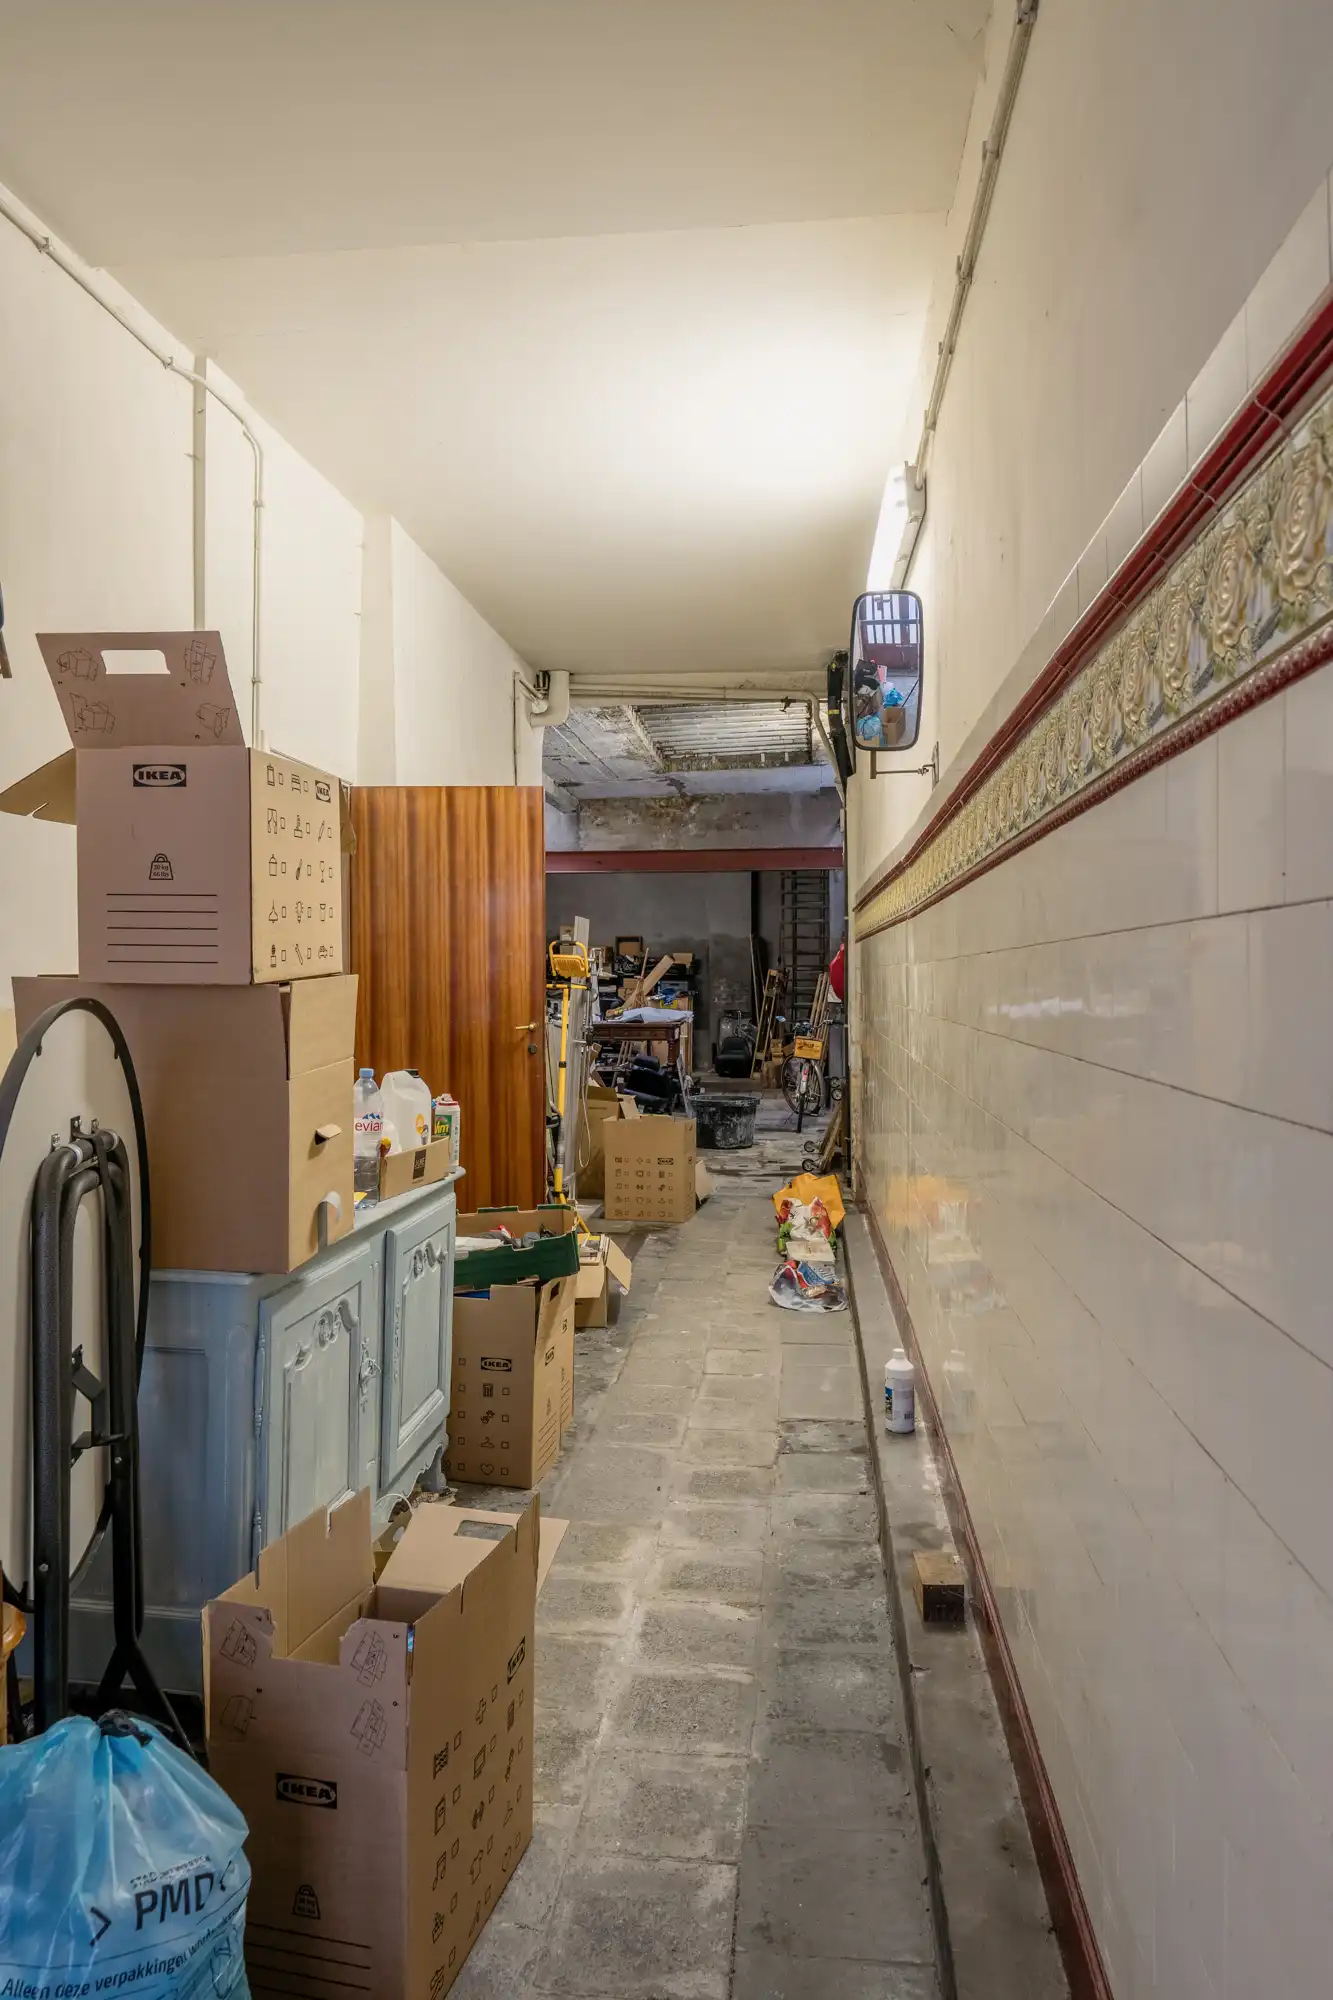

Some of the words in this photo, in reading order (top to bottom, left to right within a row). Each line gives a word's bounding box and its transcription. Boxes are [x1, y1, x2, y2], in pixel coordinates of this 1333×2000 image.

[138, 771, 183, 781] IKEA
[483, 1360, 509, 1368] IKEA
[282, 1781, 333, 1801] IKEA
[134, 1871, 215, 1932] PMD
[0, 1977, 51, 1999] Alleen
